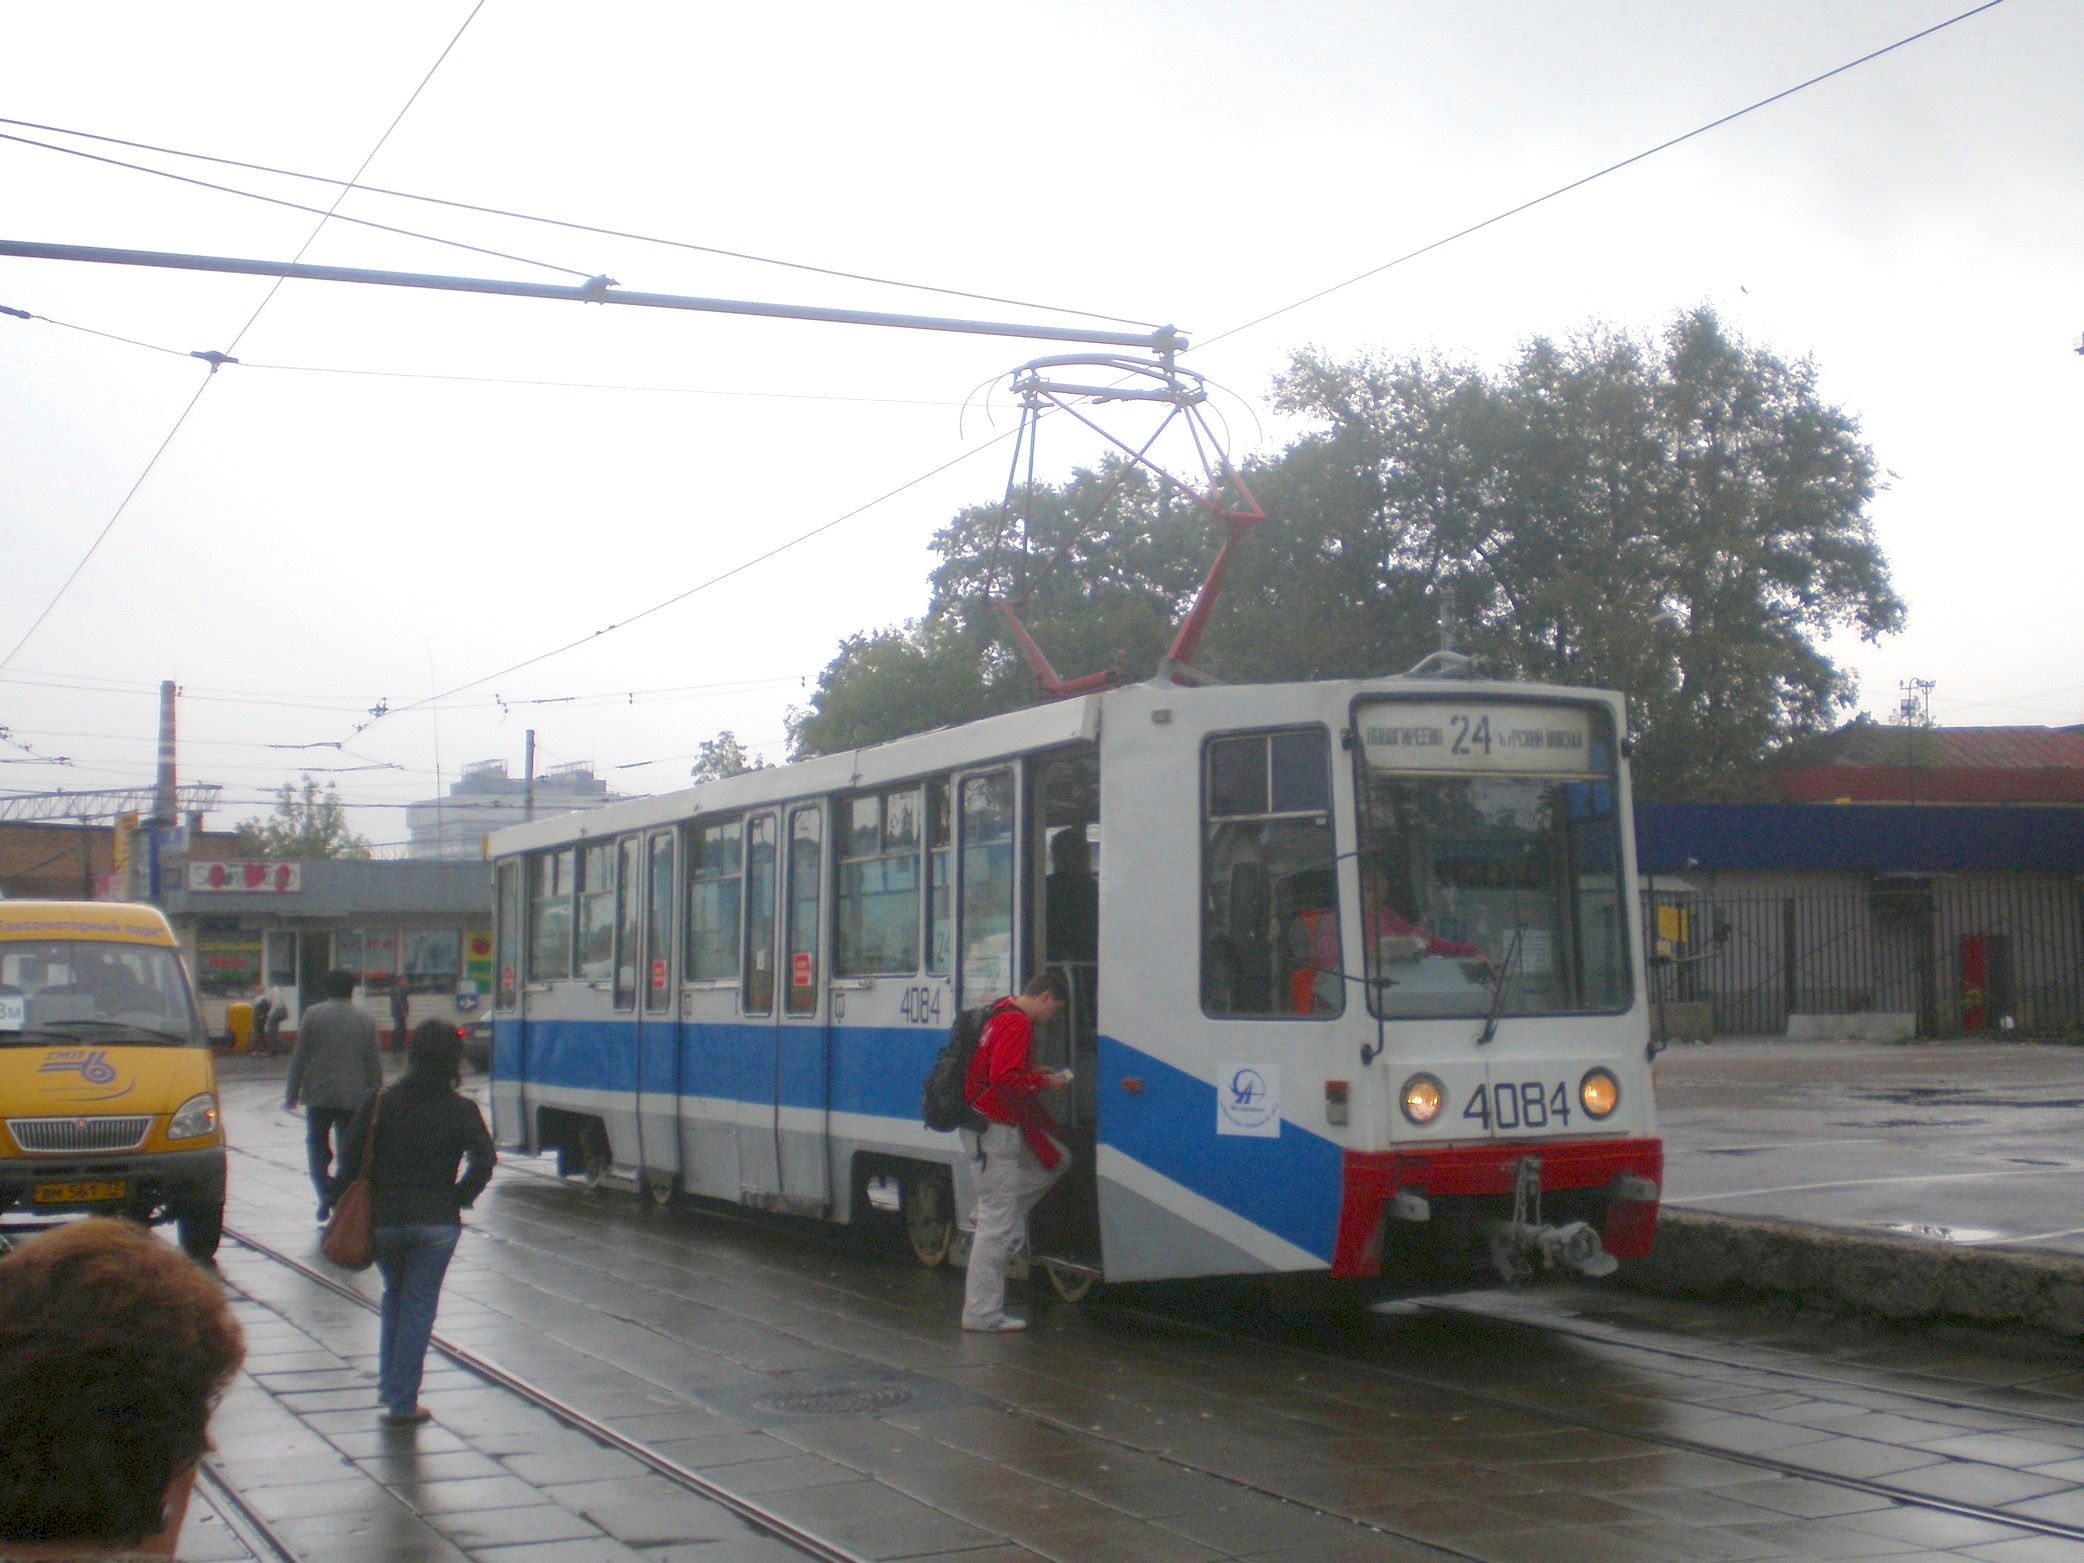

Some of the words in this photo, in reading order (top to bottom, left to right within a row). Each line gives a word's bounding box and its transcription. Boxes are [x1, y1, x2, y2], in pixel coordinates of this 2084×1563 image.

[1450, 714, 1492, 755] 24
[900, 986, 941, 1024] 4084
[46, 1050, 84, 1061] ТМП
[1463, 1081, 1571, 1130] 4084
